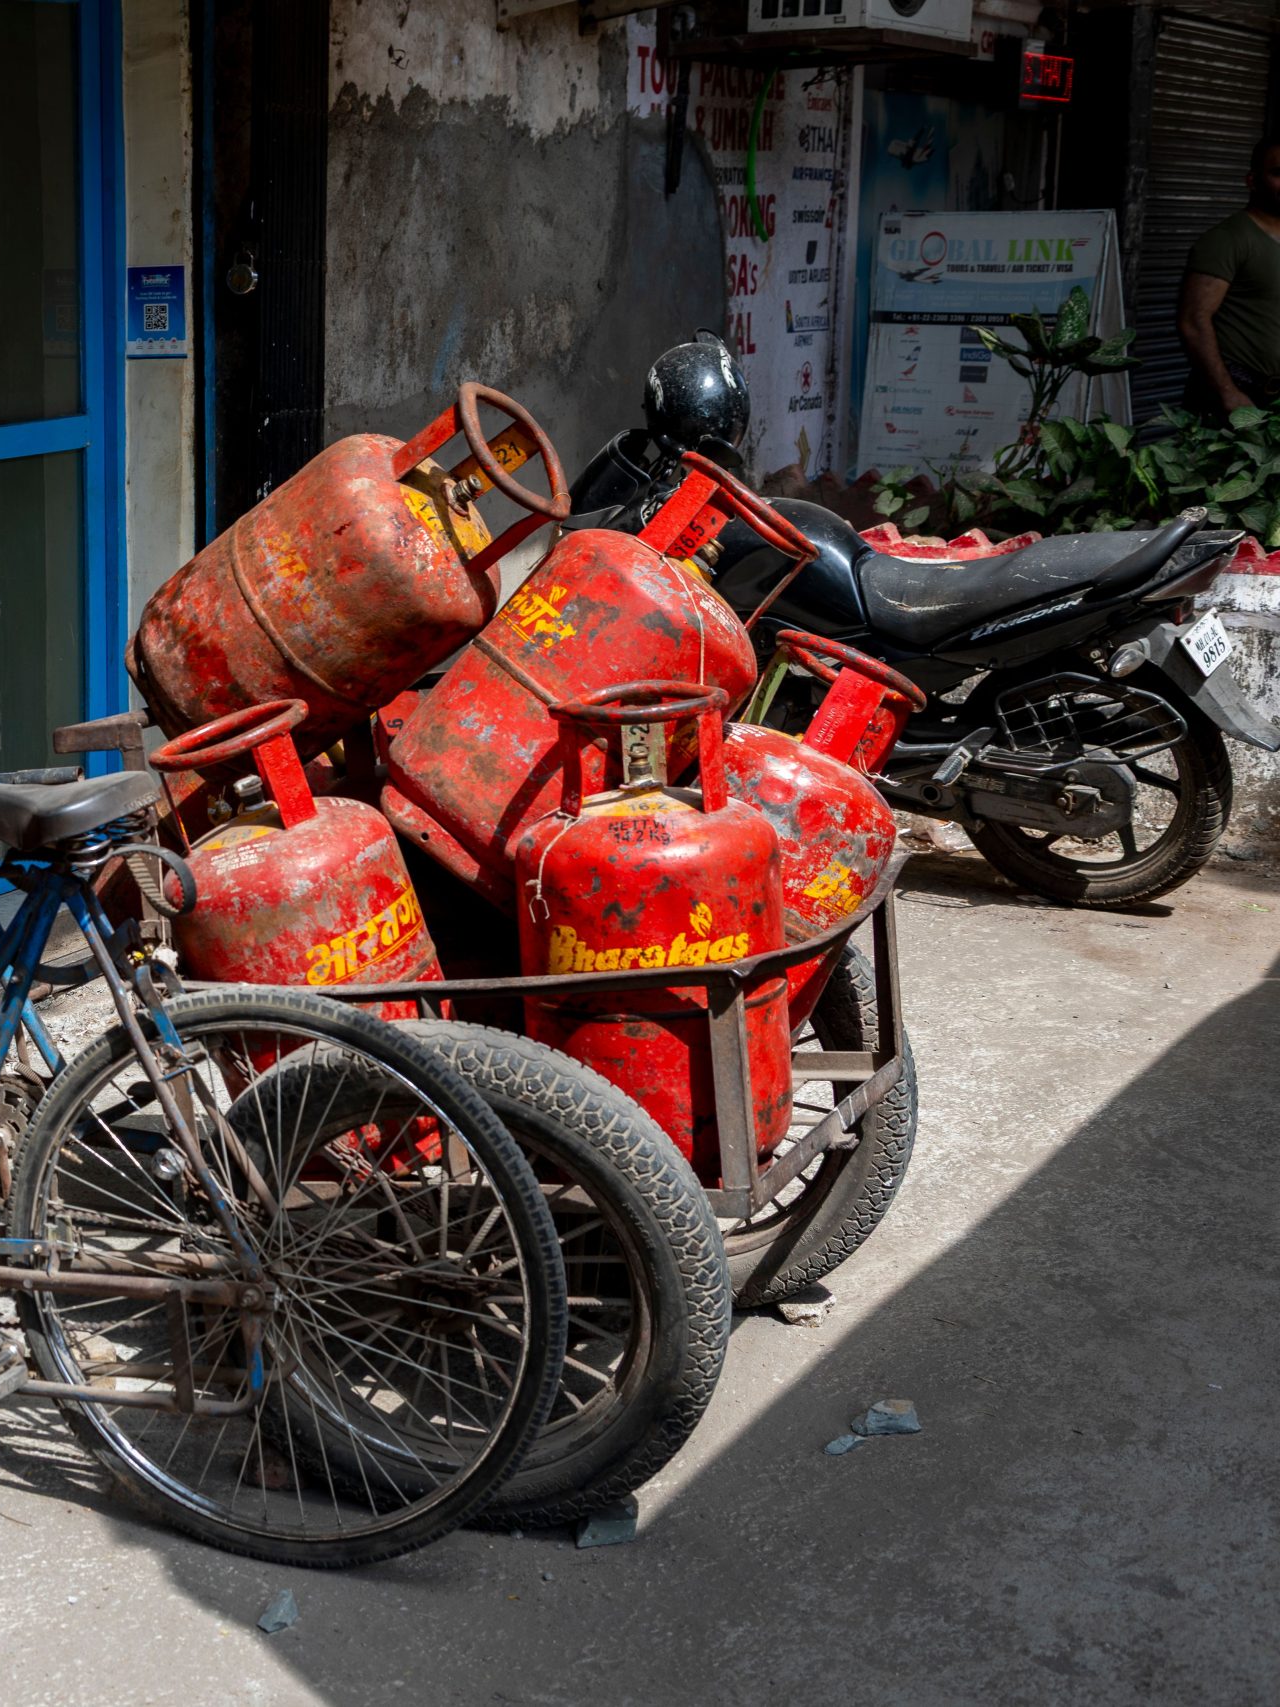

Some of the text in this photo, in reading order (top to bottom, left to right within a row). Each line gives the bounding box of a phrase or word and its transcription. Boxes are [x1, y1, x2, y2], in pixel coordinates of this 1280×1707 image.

[890, 231, 1077, 266] GLOBAL LINK
[1203, 636, 1226, 668] 9815
[548, 924, 749, 974] Bharatgas
